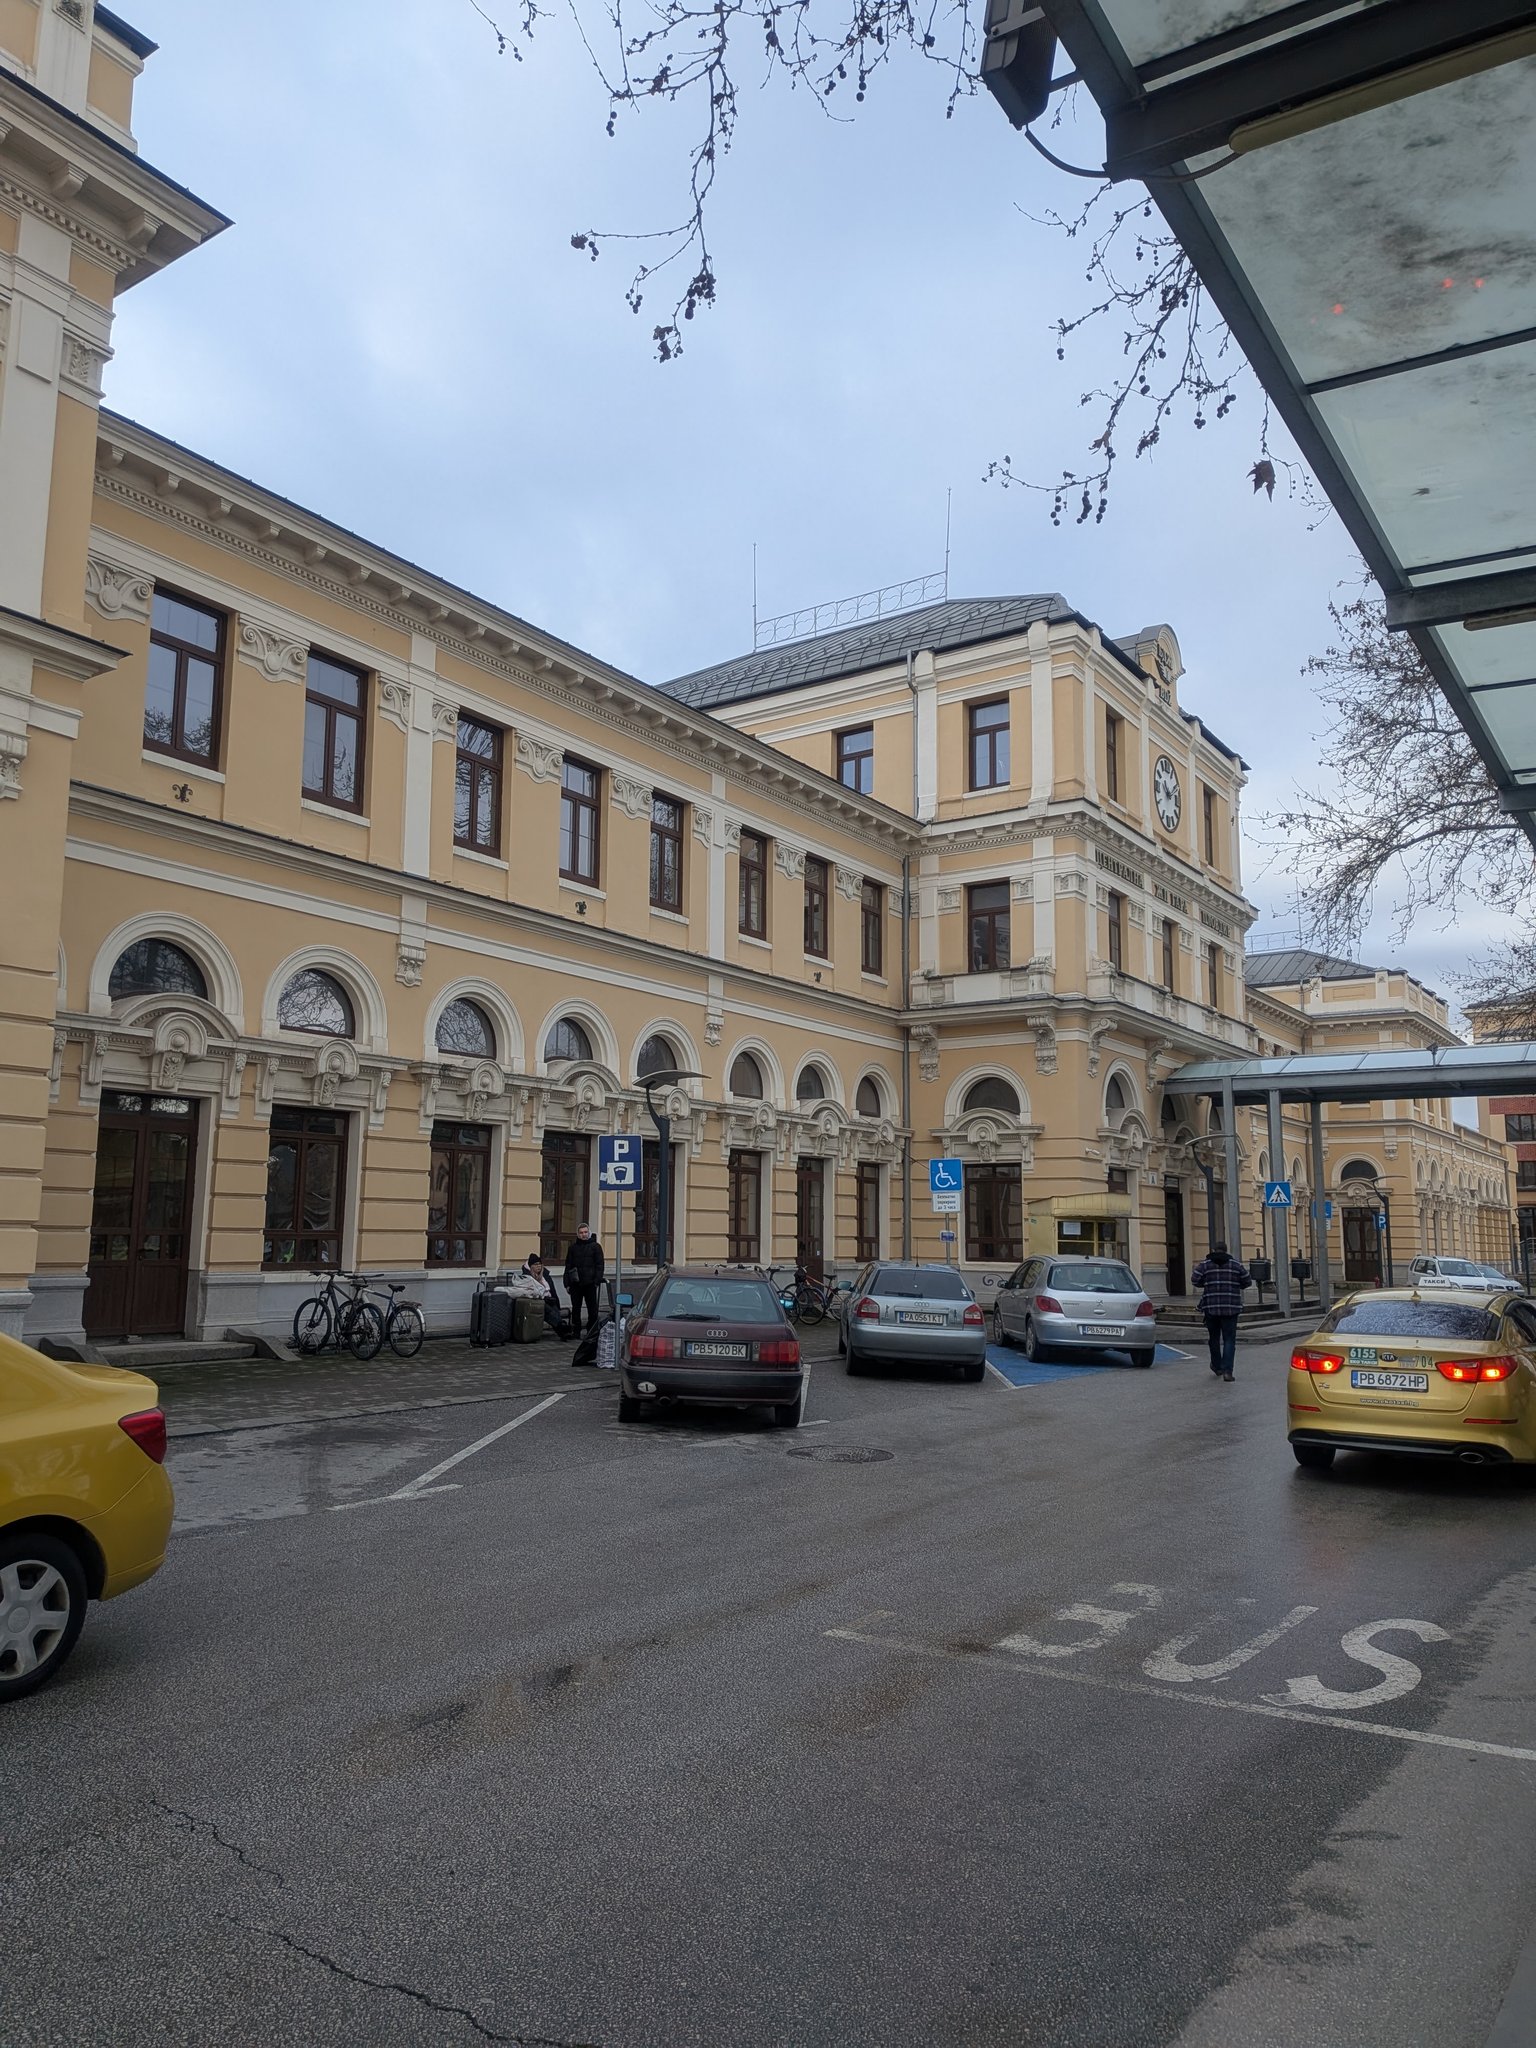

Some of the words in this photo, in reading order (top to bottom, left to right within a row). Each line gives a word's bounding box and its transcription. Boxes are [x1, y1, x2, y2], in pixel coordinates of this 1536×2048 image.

[1095, 850, 1144, 889] ЦЕНТРАЛНА
[1170, 893, 1188, 914] ГАРА
[614, 1140, 629, 1161] P
[1379, 1216, 1386, 1228] P
[707, 1344, 730, 1355] 5120
[731, 1345, 744, 1356] BK
[1350, 1348, 1376, 1359] 6155
[1359, 1373, 1375, 1385] PB
[1377, 1374, 1407, 1387] 6872
[1408, 1376, 1425, 1388] HP
